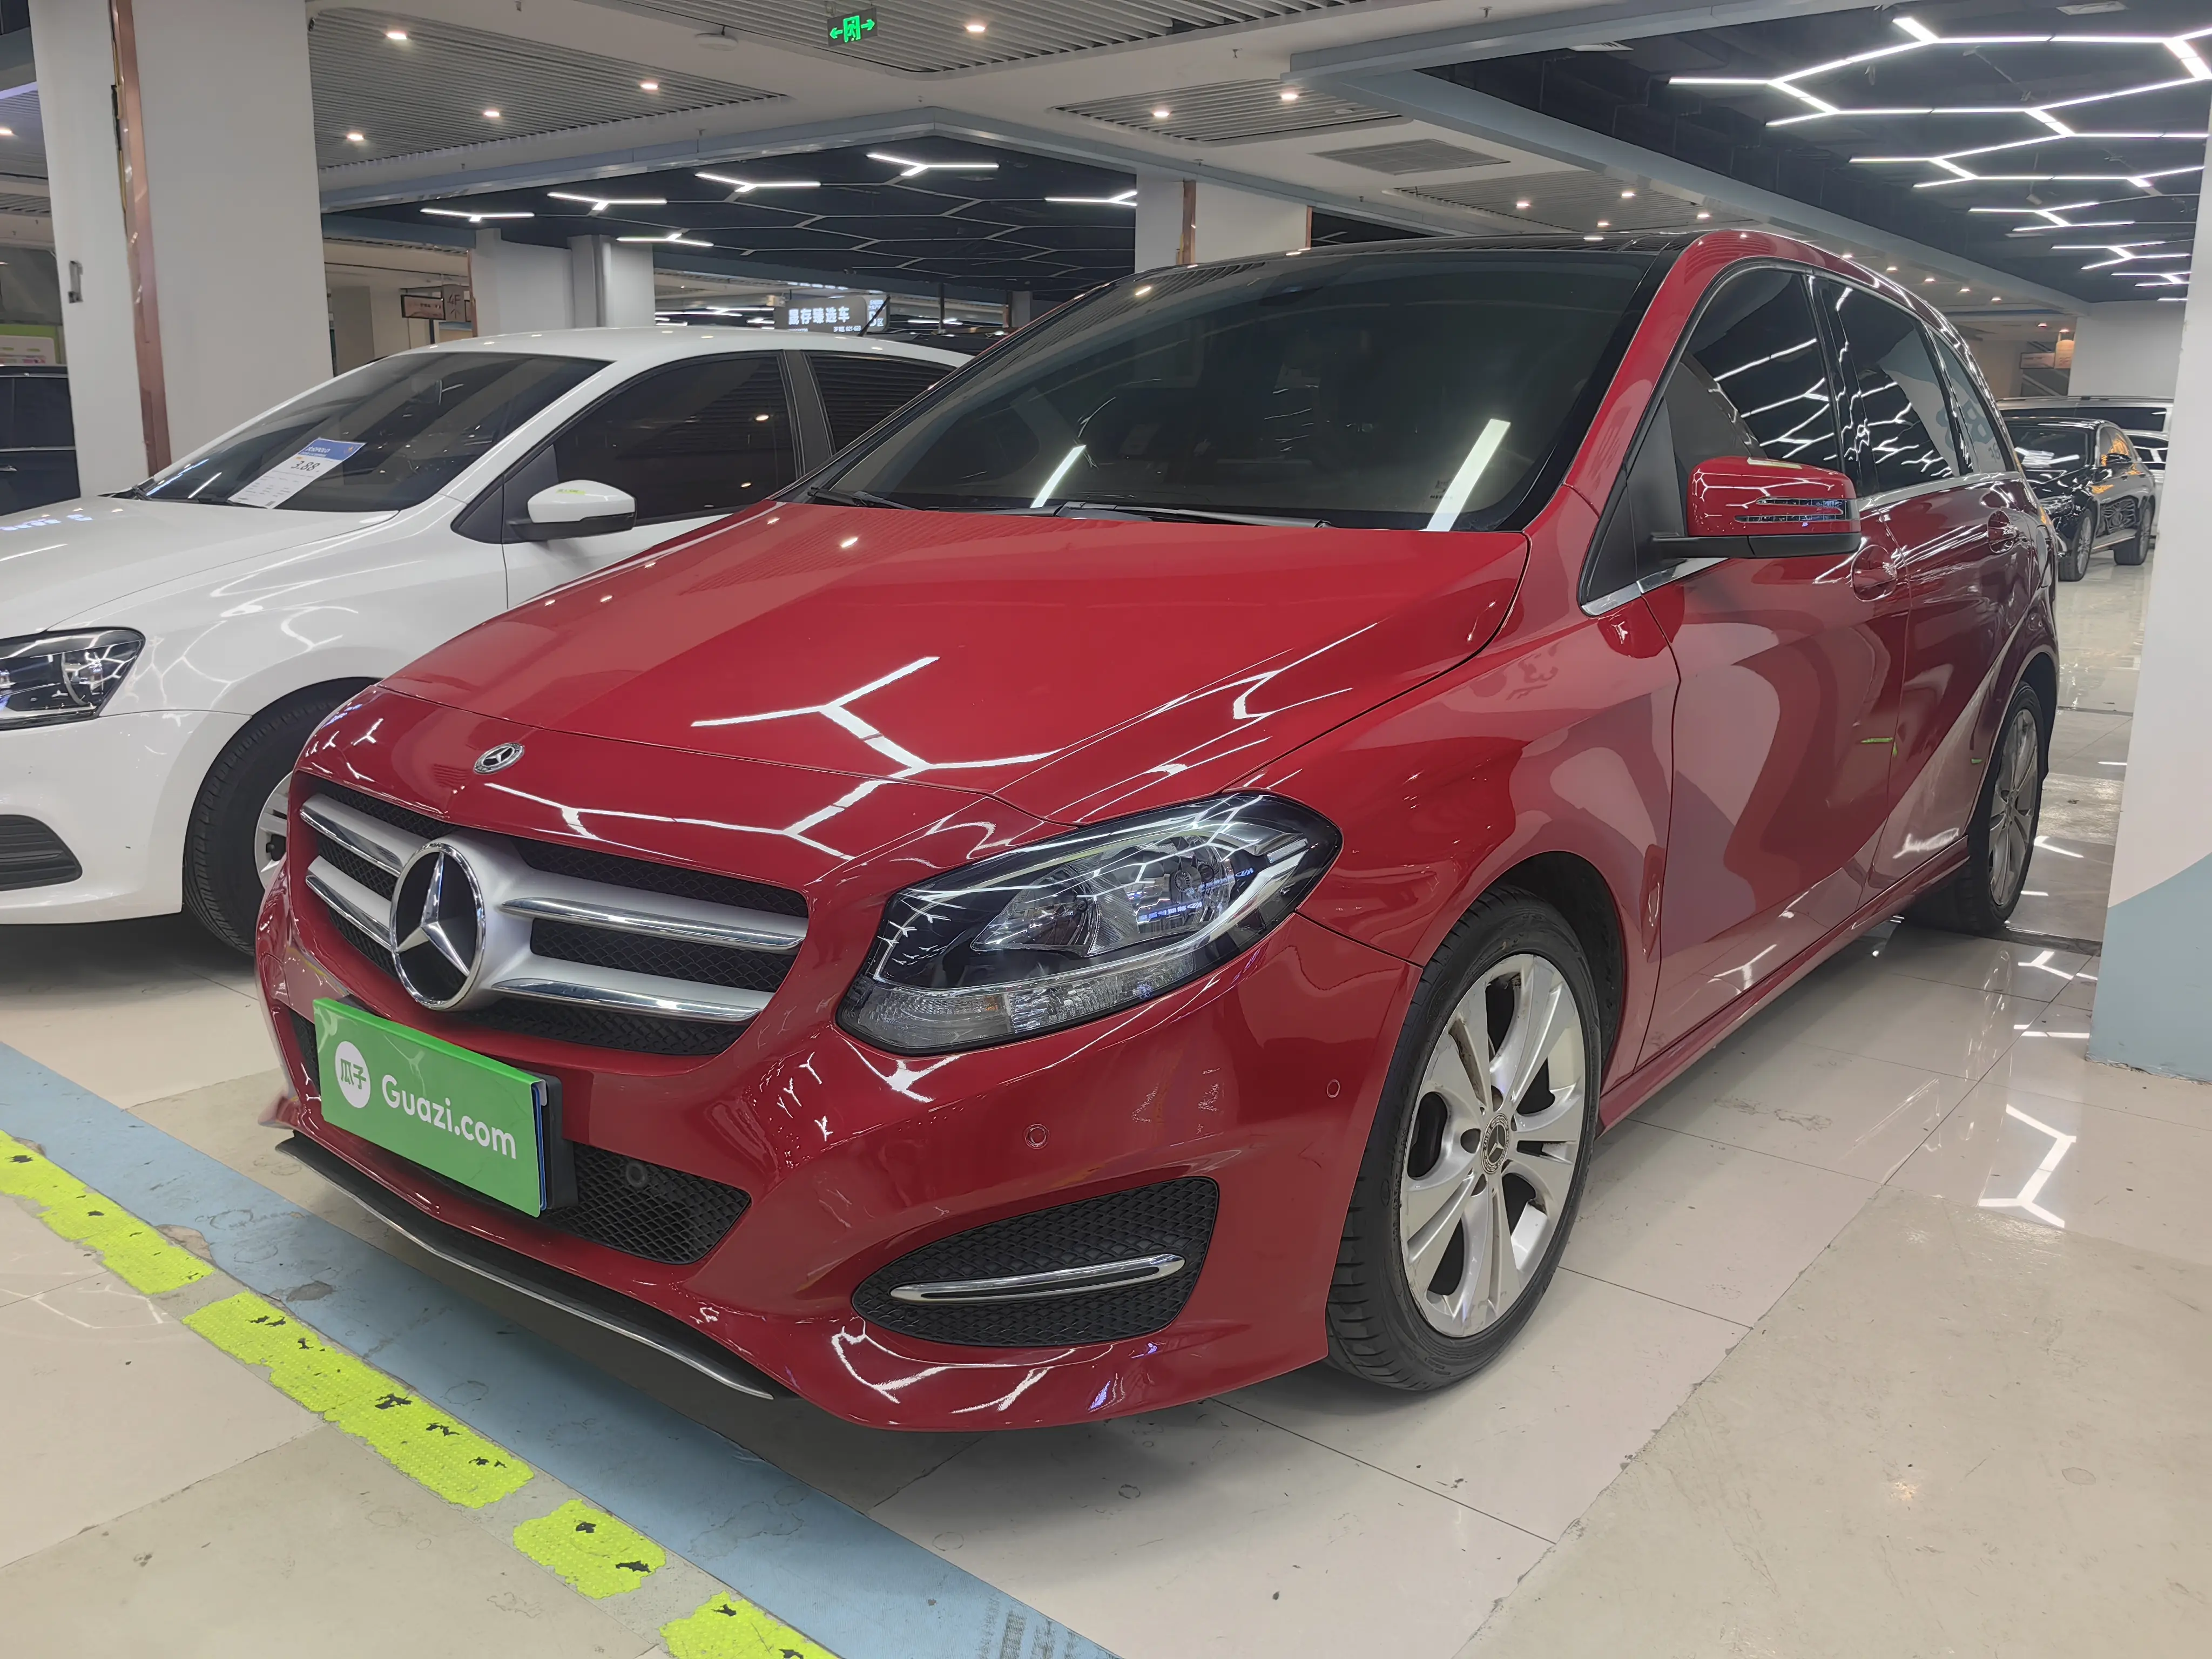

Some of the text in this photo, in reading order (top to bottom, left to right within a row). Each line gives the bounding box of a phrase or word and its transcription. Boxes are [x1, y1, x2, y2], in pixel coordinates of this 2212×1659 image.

[447, 294, 461, 305] 4F
[340, 1058, 367, 1090] 瓜子
[382, 1074, 516, 1159] Guazi.com
